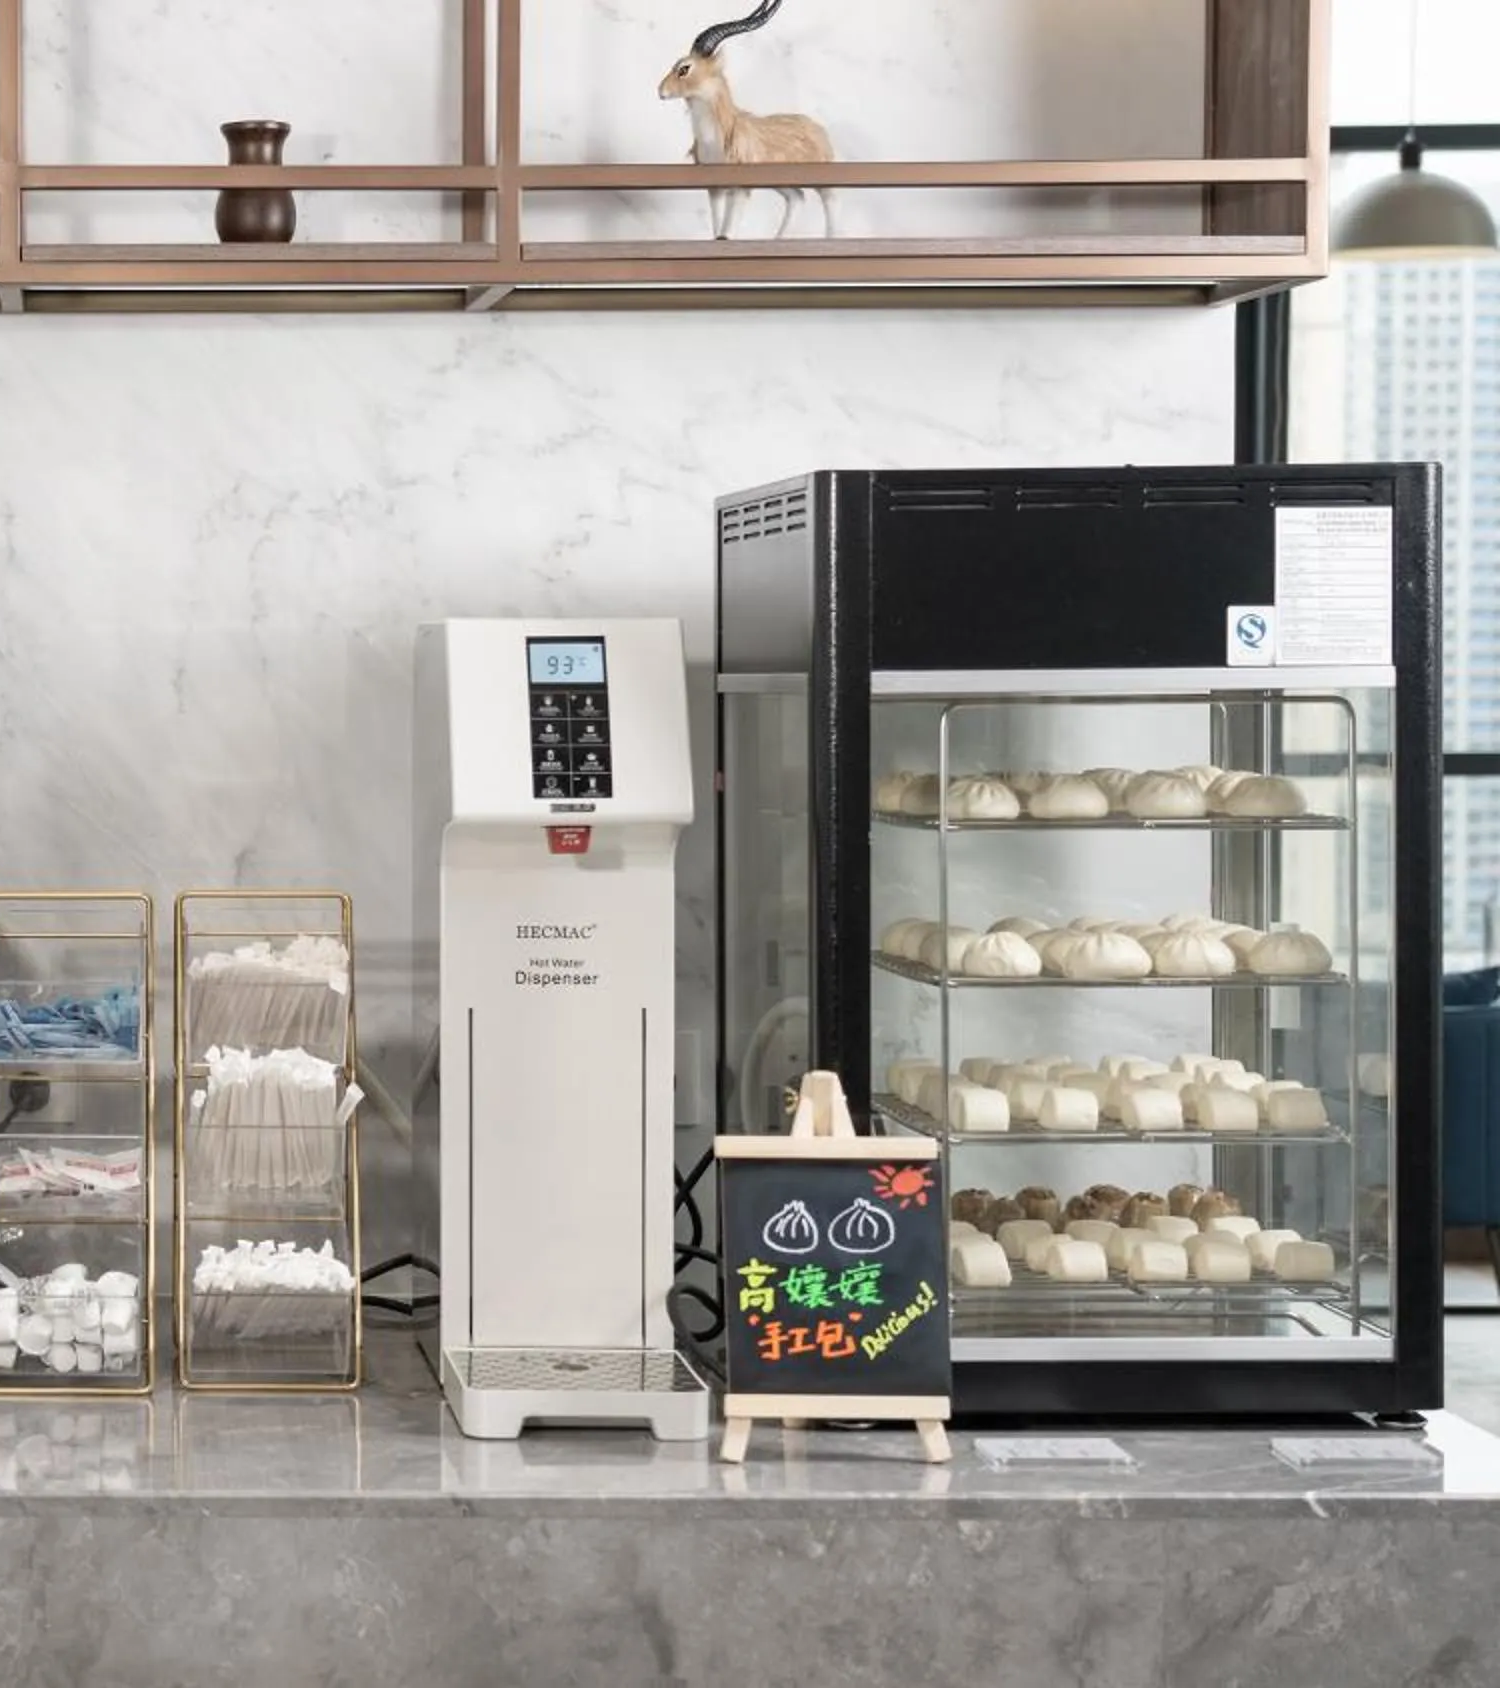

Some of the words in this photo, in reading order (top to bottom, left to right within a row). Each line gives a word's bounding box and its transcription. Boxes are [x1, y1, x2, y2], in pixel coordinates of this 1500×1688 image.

[515, 971, 599, 987] Dispenser
[758, 1320, 857, 1360] 手工包
